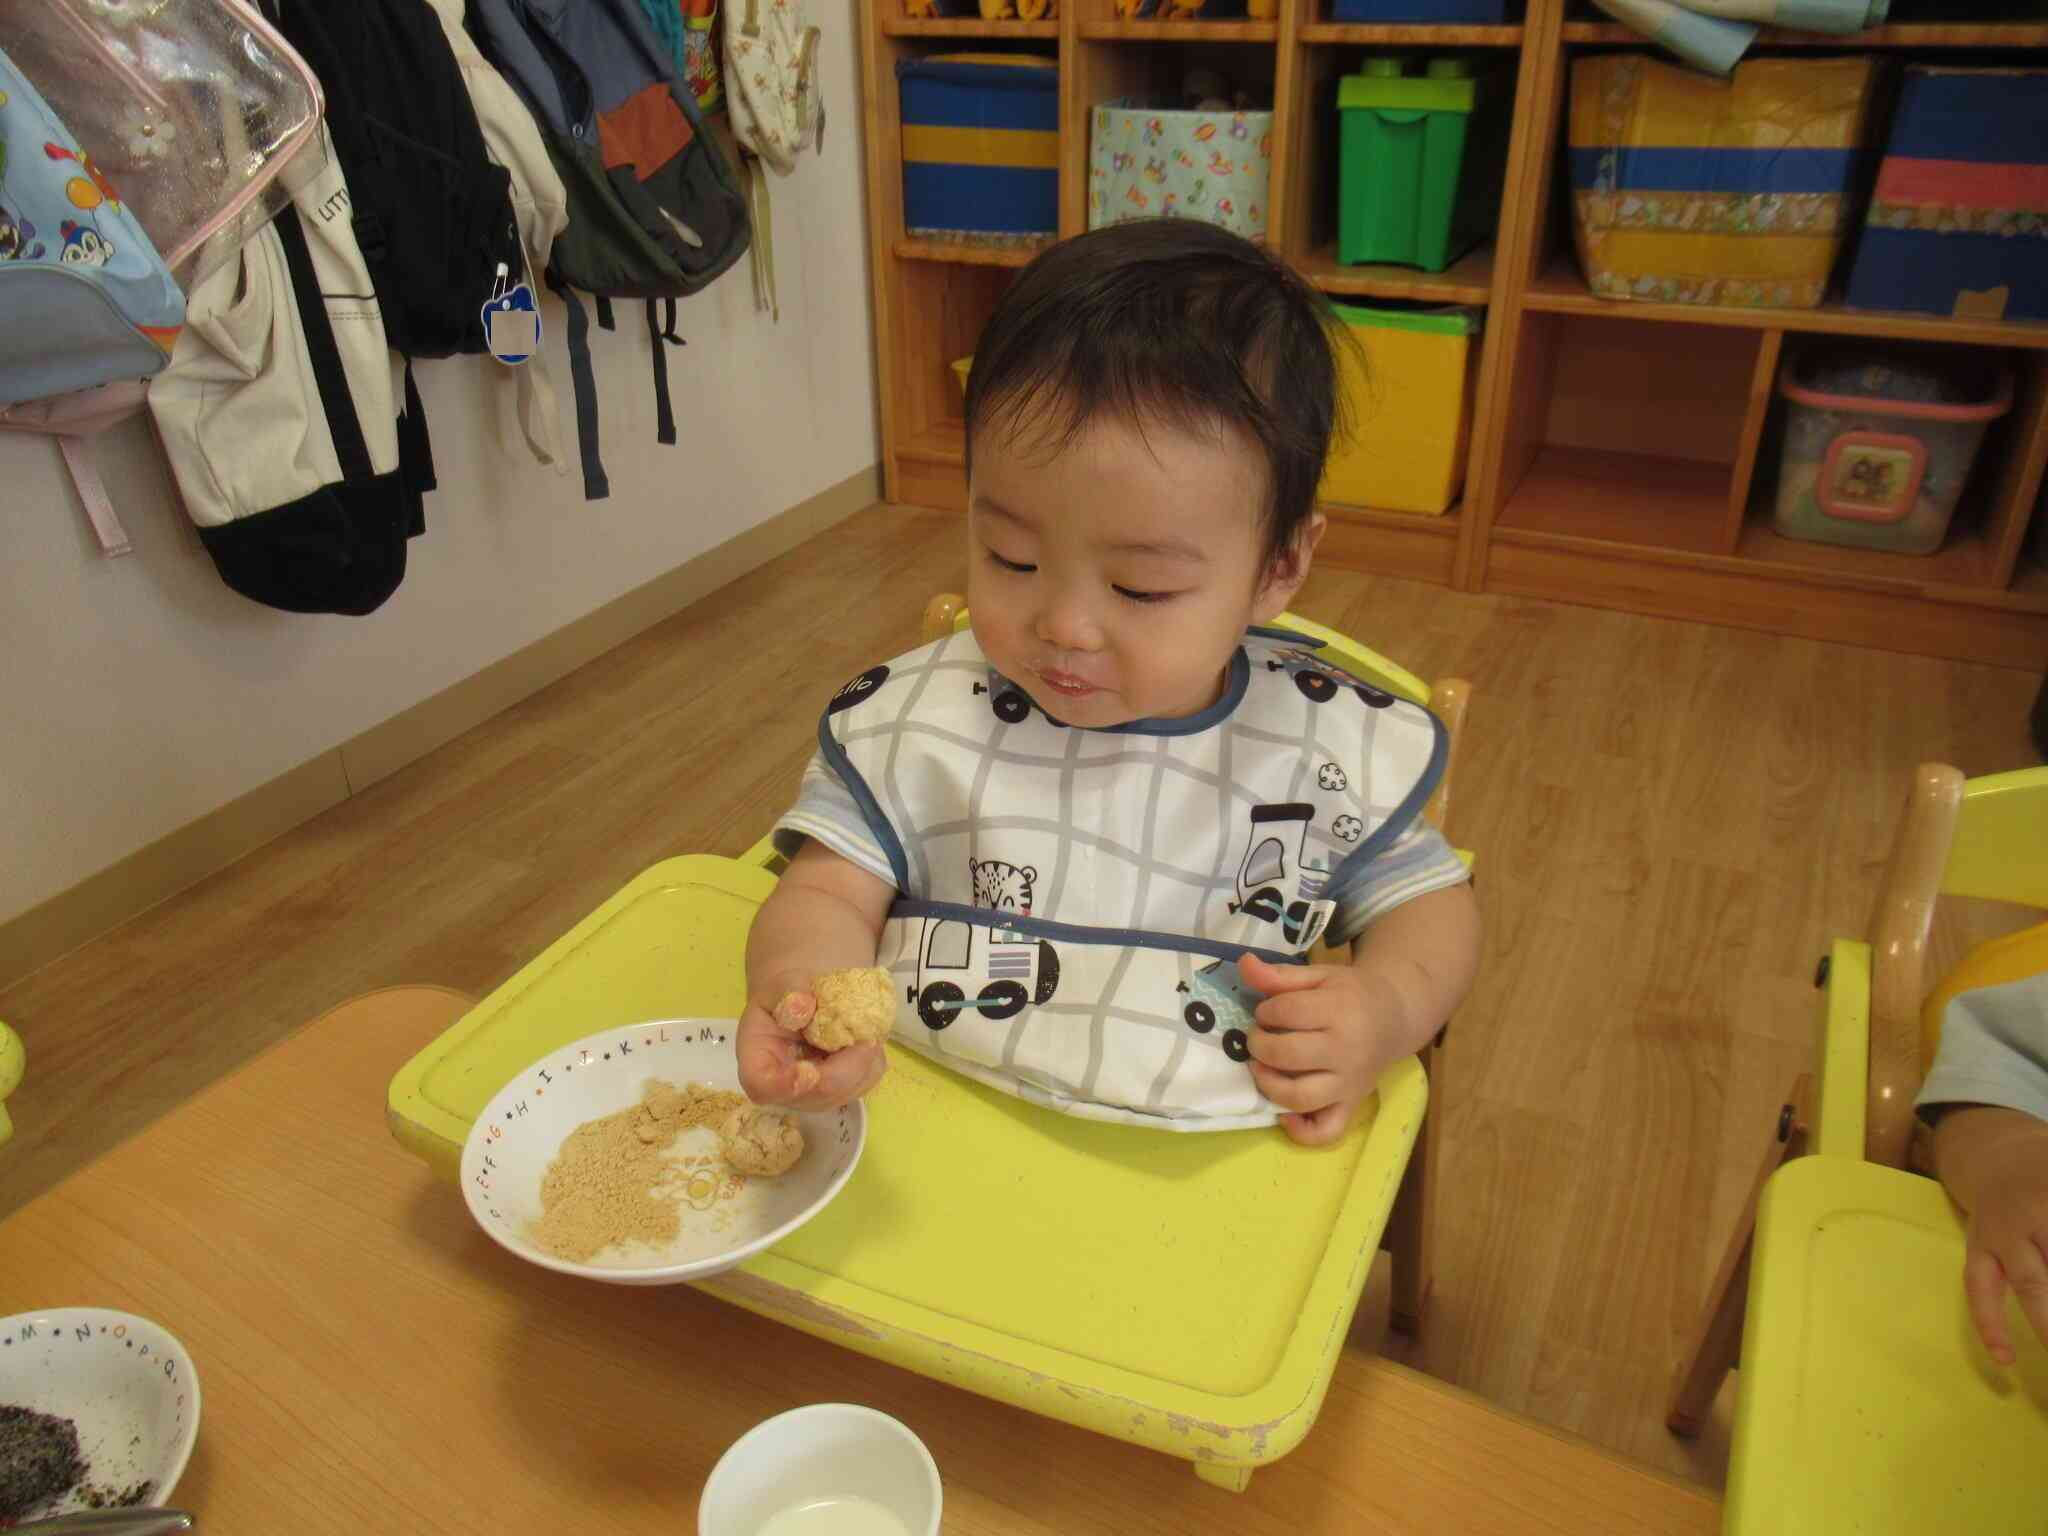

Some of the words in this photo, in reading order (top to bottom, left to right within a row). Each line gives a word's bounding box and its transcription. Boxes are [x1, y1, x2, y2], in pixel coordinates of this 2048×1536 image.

[514, 1100, 529, 1117] H
[538, 1070, 553, 1083] I
[619, 1040, 633, 1055] K
[660, 1028, 670, 1042] L
[700, 1027, 714, 1041] M
[21, 1324, 37, 1340] M
[76, 1323, 91, 1342] N
[113, 1324, 126, 1338] O
[138, 1344, 149, 1356] P
[164, 1359, 175, 1378] Q
